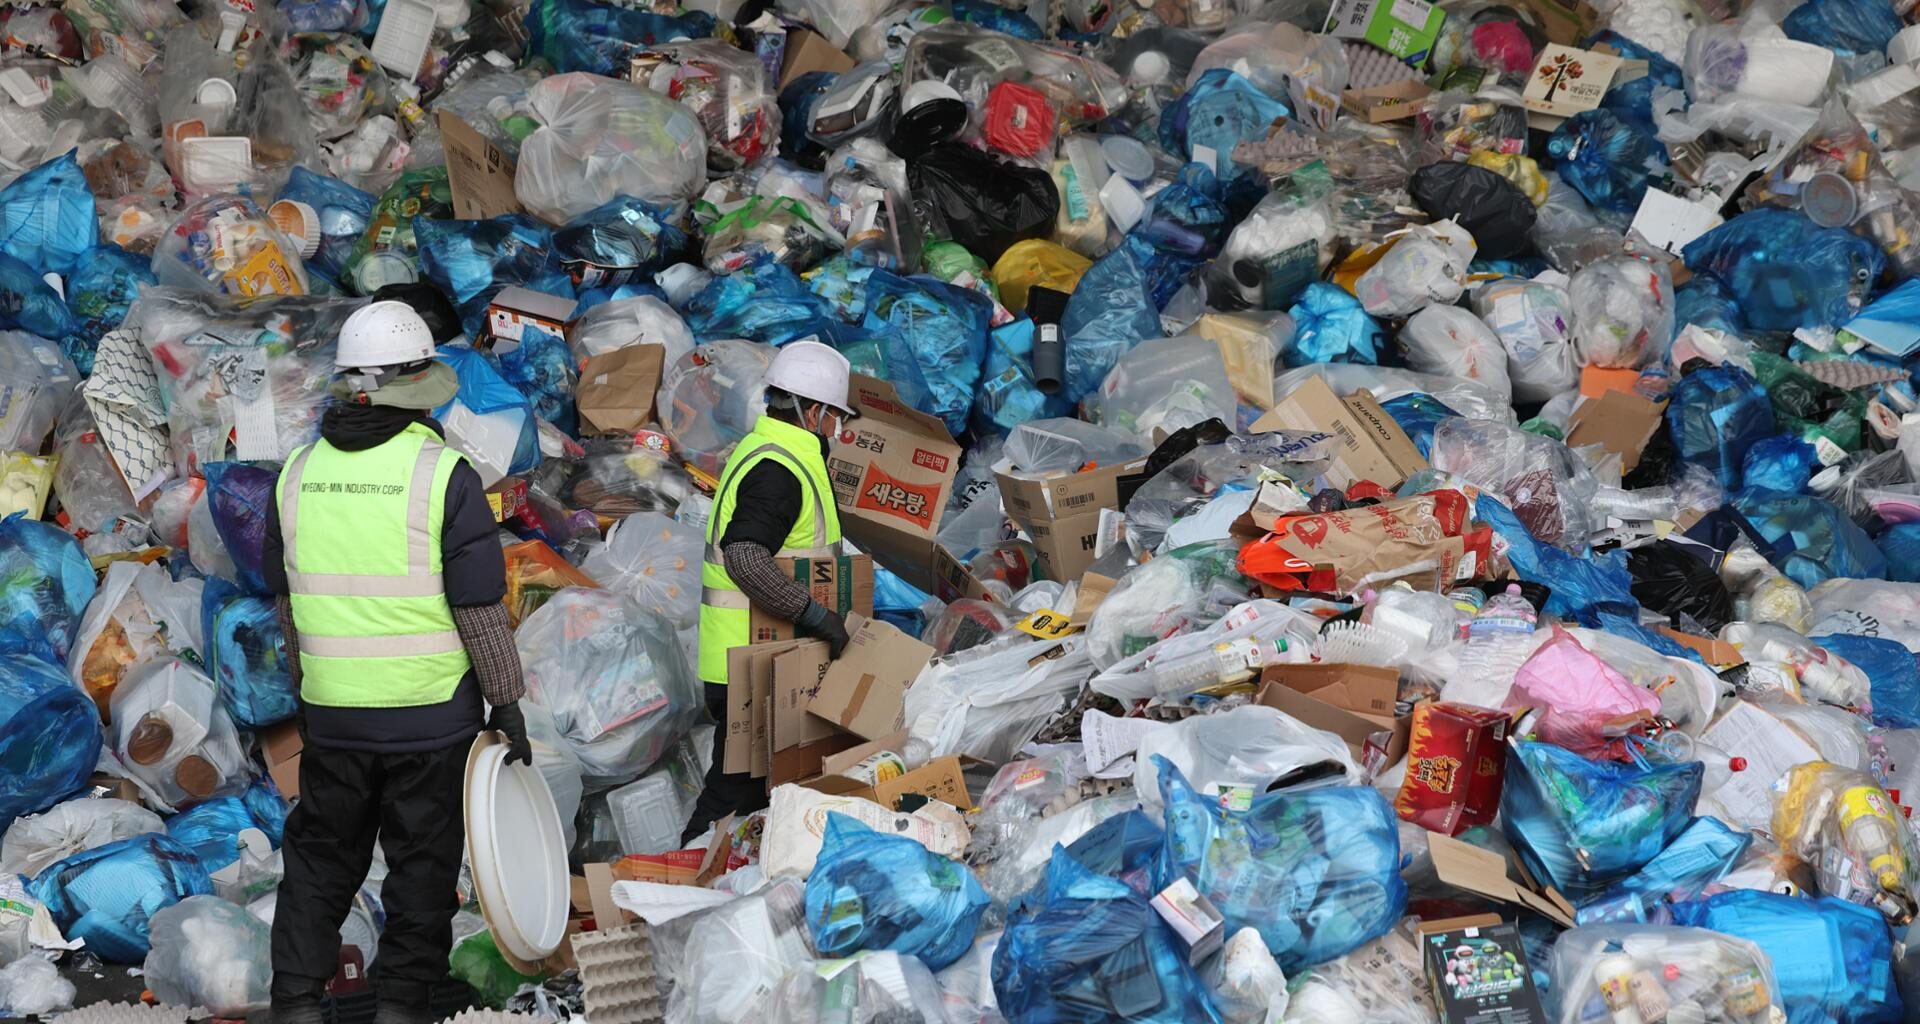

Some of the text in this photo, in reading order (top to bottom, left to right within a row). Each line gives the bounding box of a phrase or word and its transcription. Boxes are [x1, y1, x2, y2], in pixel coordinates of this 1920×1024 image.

[1352, 401, 1391, 440] coupang
[855, 435, 885, 454] 농심
[916, 451, 945, 471] 멀티팩
[301, 482, 404, 495] MYEONG-MIN INDUSTRY CORP
[865, 481, 926, 516] 새우탕
[1416, 757, 1433, 783] 핫팩
